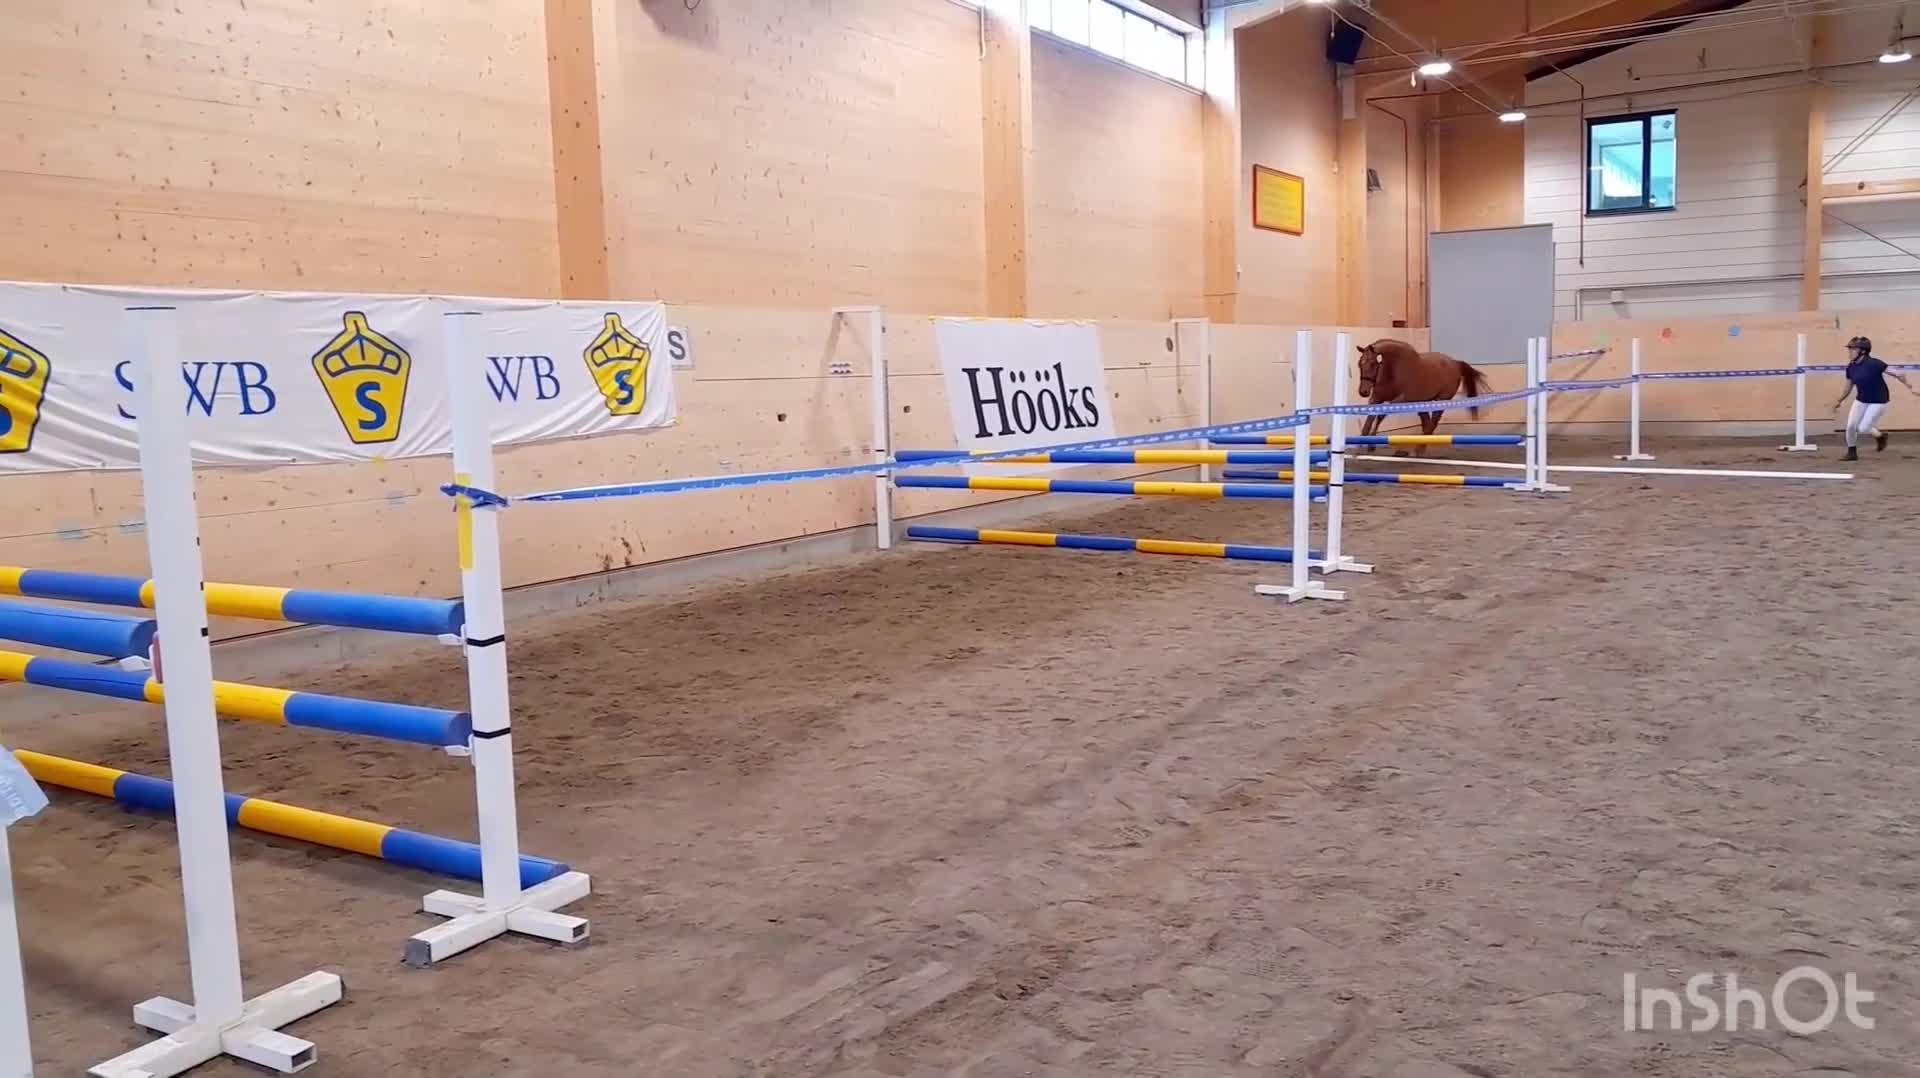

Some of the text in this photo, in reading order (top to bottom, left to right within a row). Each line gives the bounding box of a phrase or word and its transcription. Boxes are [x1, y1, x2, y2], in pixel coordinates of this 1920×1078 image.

[667, 330, 686, 360] S
[486, 355, 560, 403] WB
[614, 369, 634, 405] S
[961, 361, 1099, 438] Hööks
[355, 381, 387, 430] S
